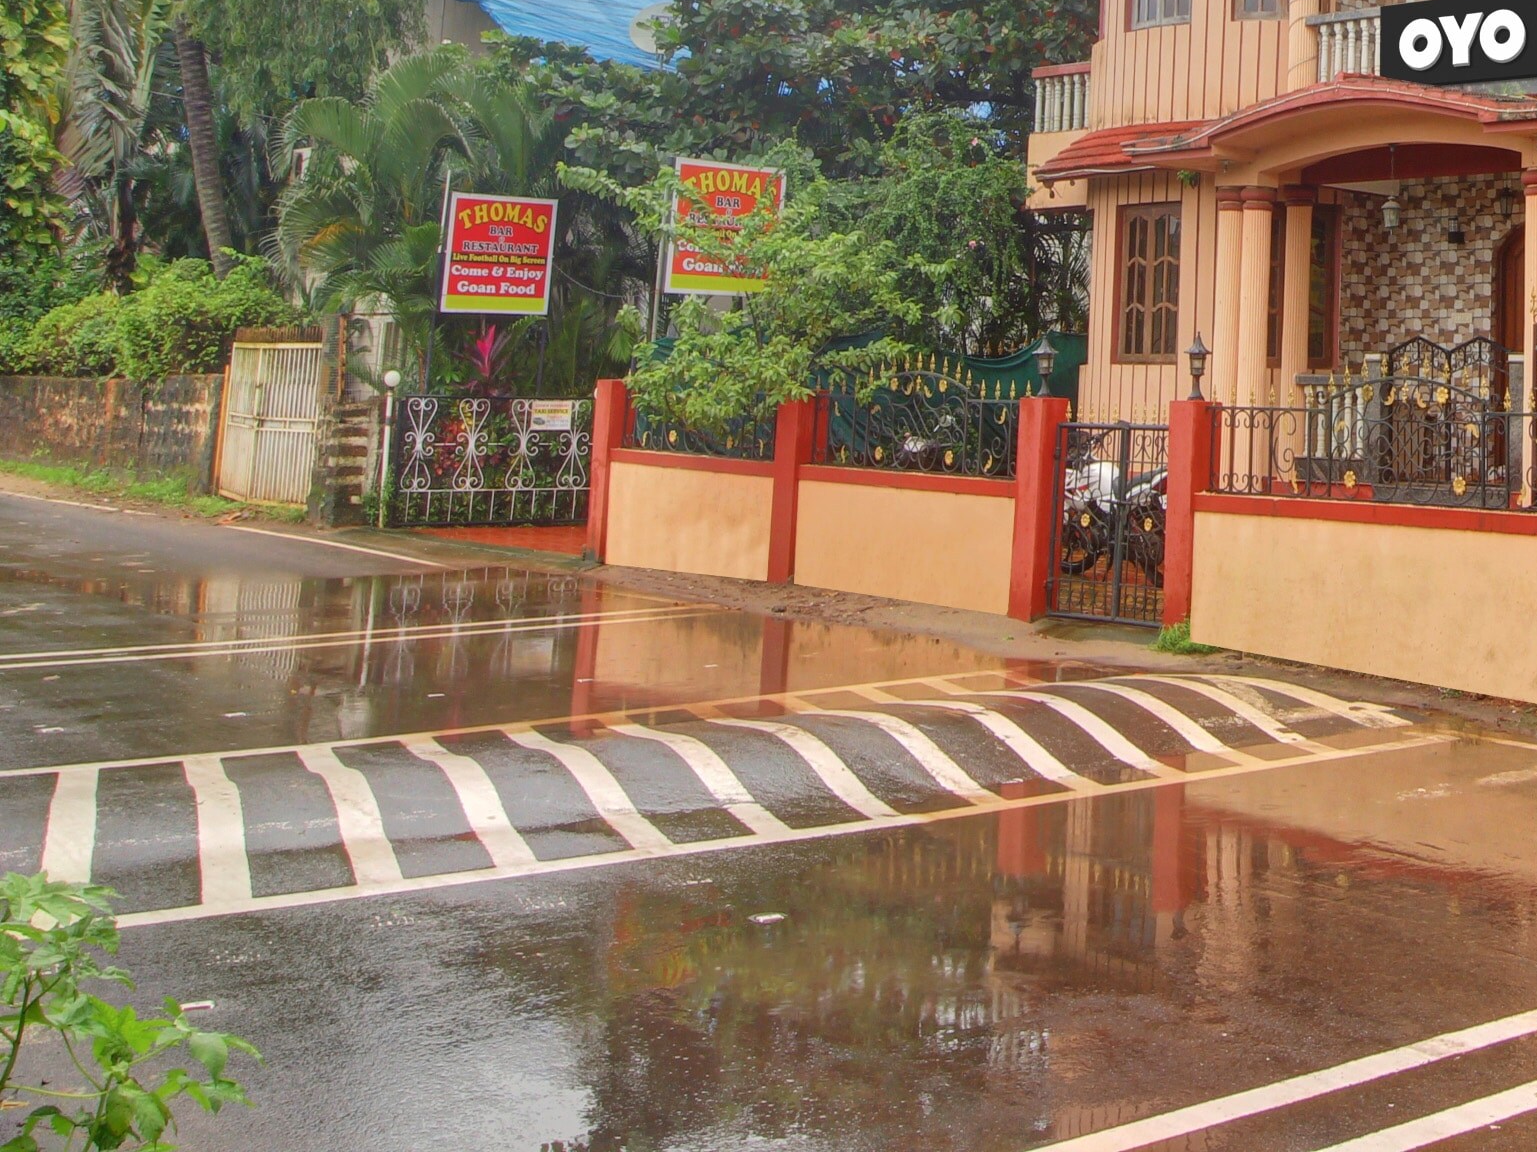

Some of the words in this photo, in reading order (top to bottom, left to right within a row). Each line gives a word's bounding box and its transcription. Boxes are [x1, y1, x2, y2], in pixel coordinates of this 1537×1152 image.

[1399, 9, 1527, 71] OYO
[716, 196, 741, 209] BAR
[458, 202, 548, 234] THOMAS
[489, 225, 513, 236] BAR
[463, 241, 538, 255] RESTAURANT
[453, 253, 468, 261] Live
[469, 254, 498, 263] Football
[499, 255, 509, 263] On
[510, 256, 522, 265] Big
[522, 257, 545, 265] Screen
[682, 258, 723, 273] Goan
[451, 264, 489, 276] Come
[492, 266, 504, 277] &
[506, 266, 544, 281] Enjoy
[456, 281, 496, 293] Goan
[499, 282, 536, 295] Food
